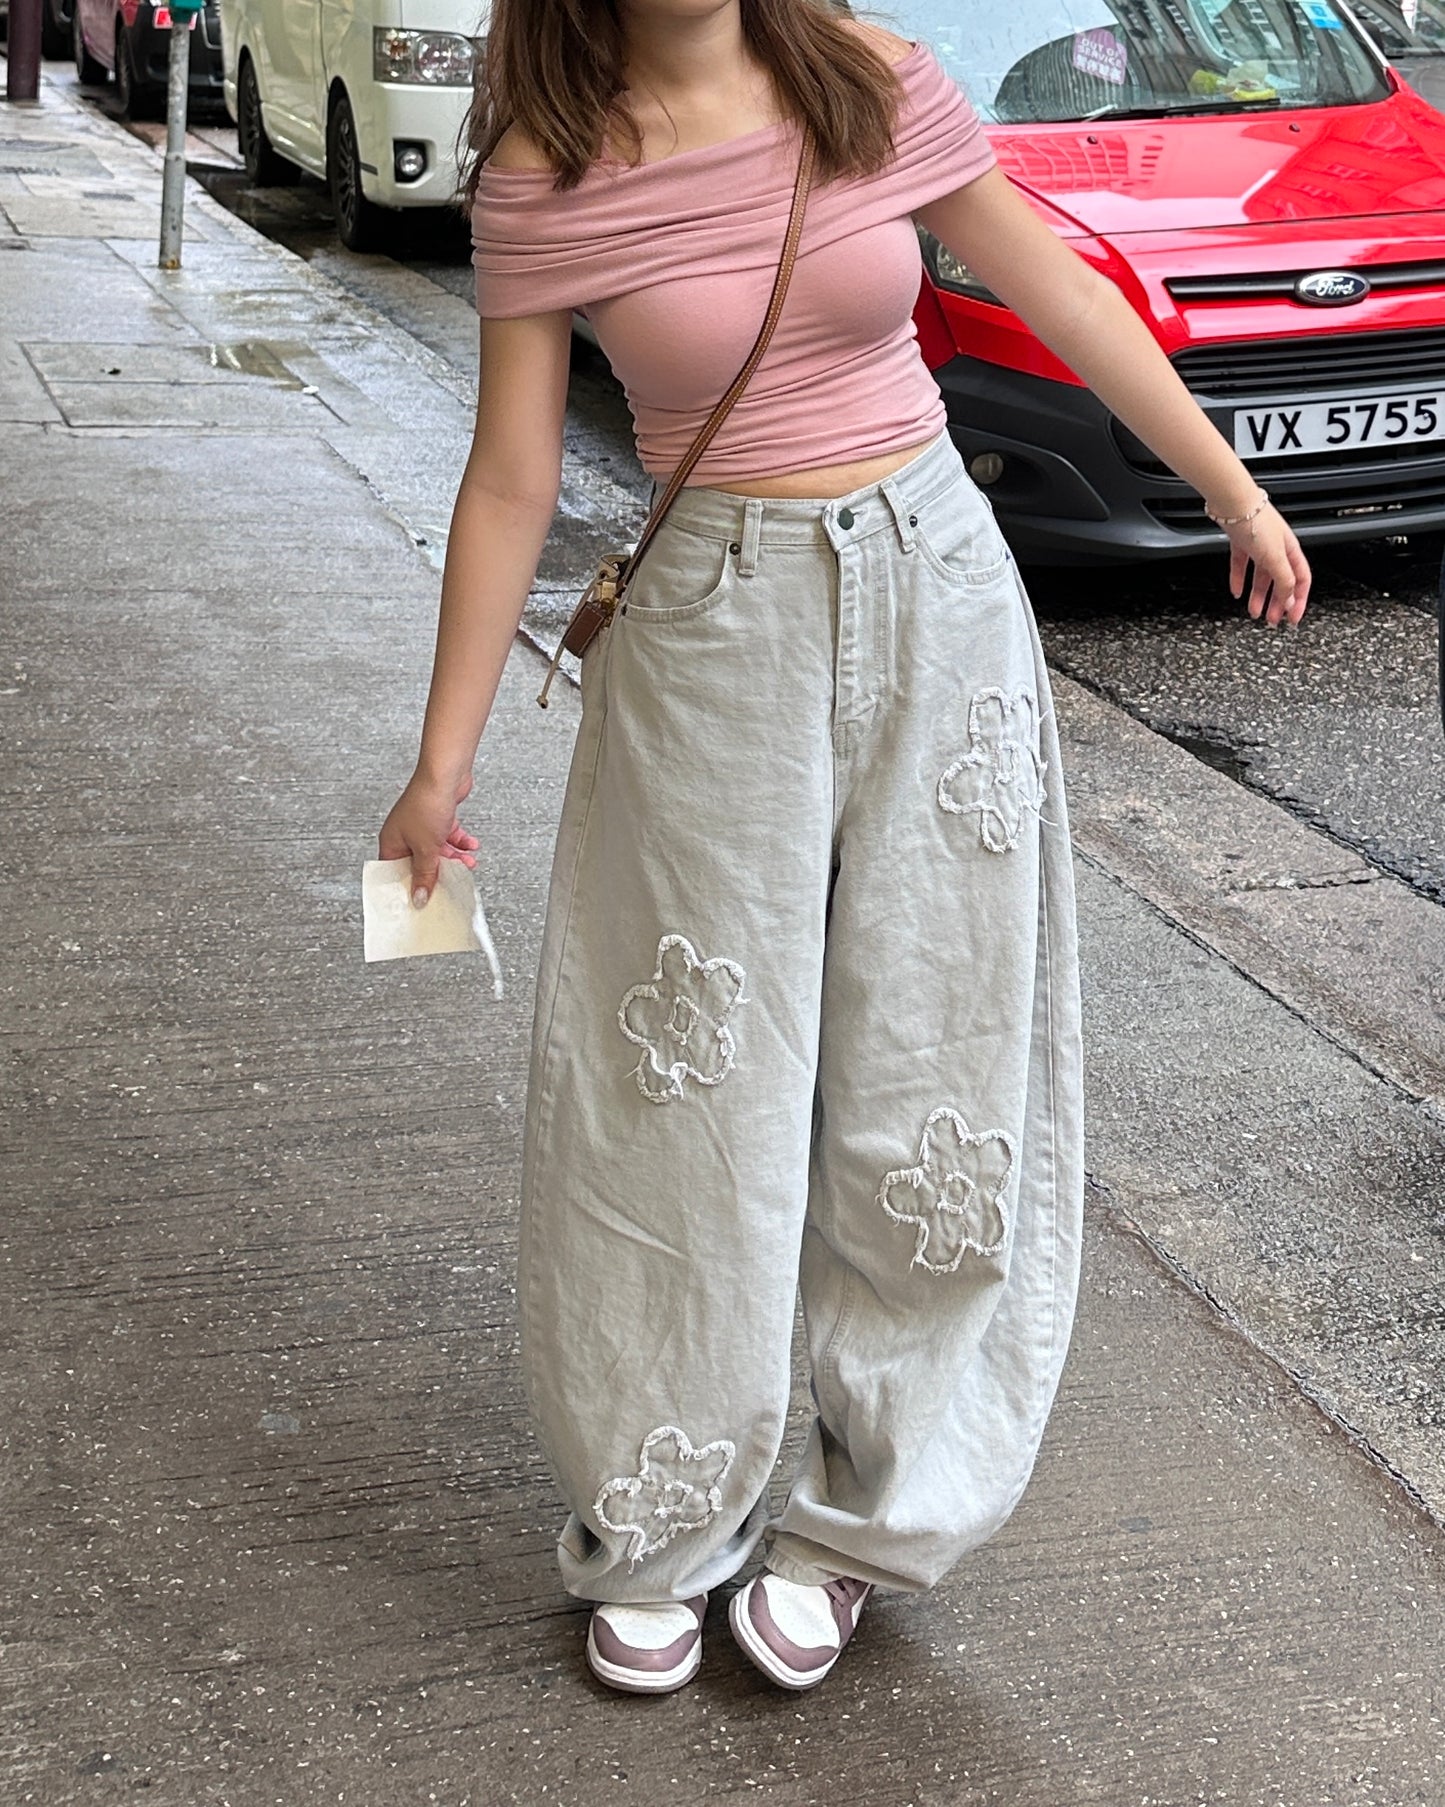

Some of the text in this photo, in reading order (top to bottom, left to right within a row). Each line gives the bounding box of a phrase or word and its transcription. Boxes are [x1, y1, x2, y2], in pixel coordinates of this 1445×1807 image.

[1077, 44, 1122, 68] SERVICE
[1081, 38, 1104, 52] OUT
[1315, 276, 1355, 297] Ford
[1246, 397, 1437, 451] VX 5755
